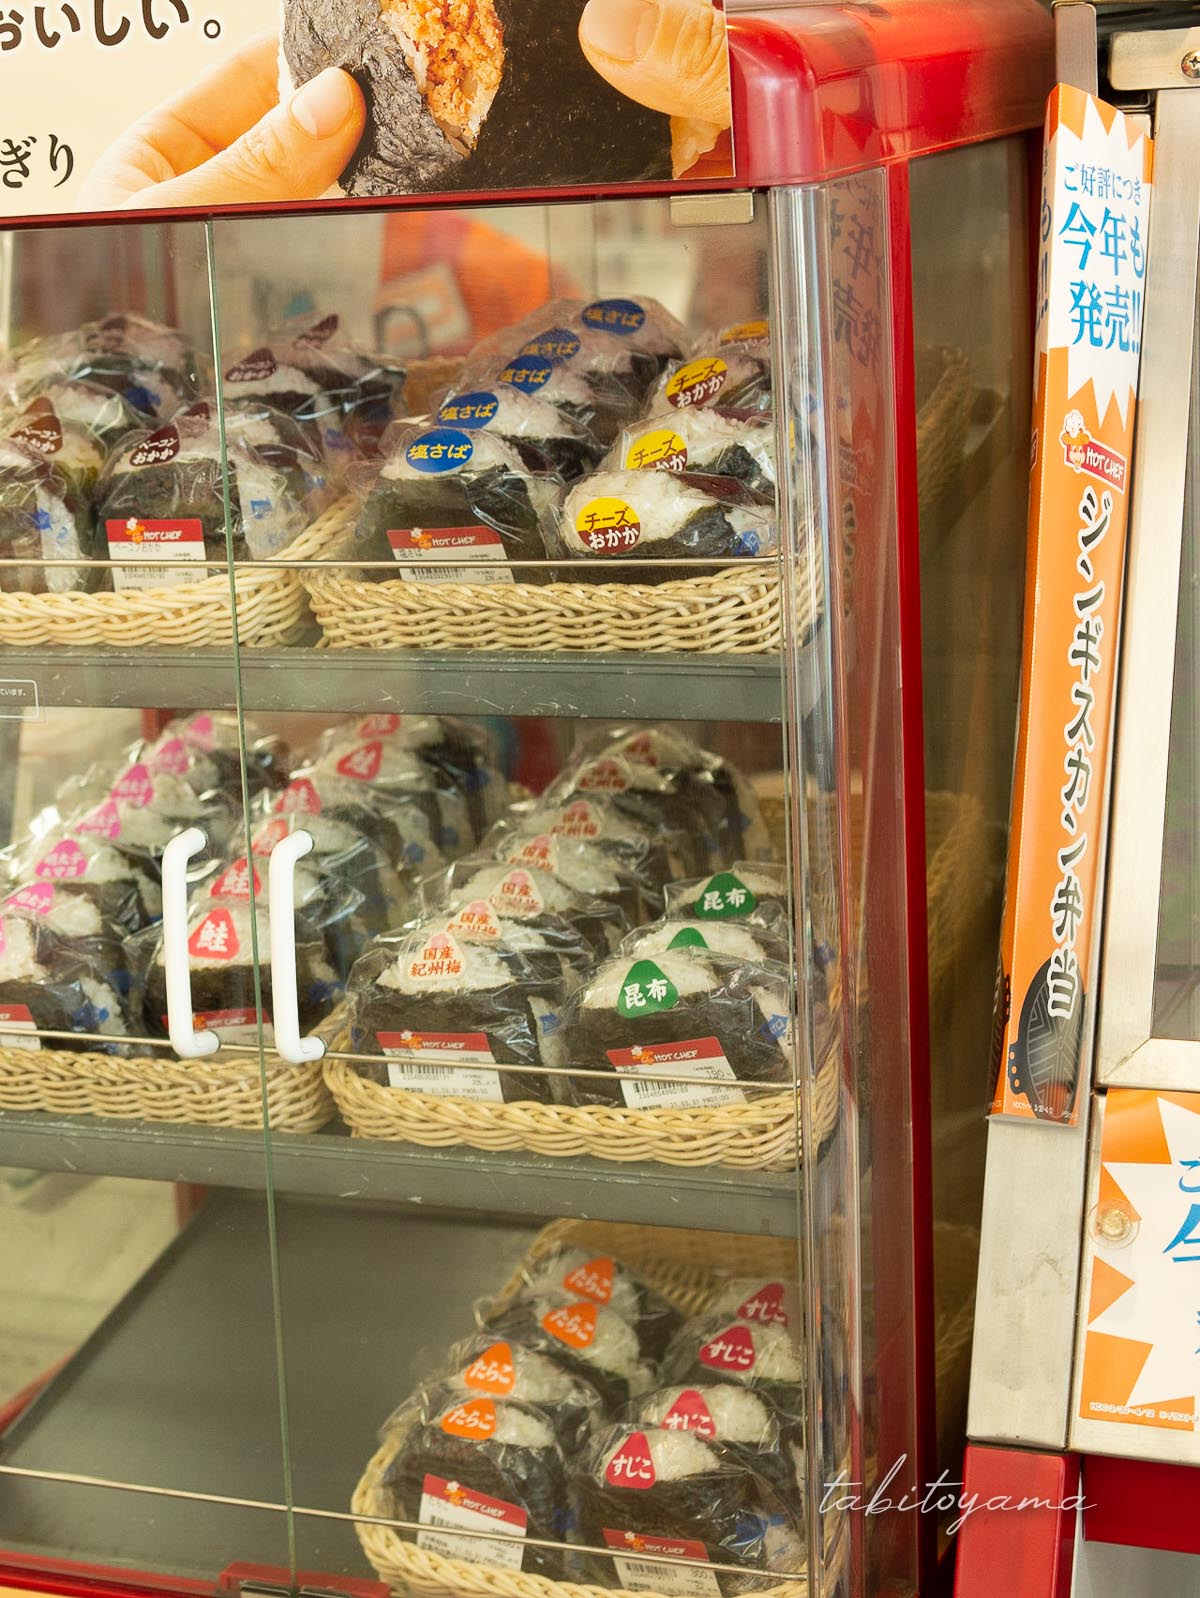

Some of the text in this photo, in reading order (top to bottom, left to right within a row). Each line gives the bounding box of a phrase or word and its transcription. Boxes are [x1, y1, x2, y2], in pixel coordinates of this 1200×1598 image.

[1064, 164, 1141, 206] ご好評につき
[1058, 202, 1145, 279] 今年も
[674, 359, 719, 391] チーズ
[676, 375, 727, 409] おかか
[441, 401, 498, 421] 塩さば
[140, 437, 178, 451] ベーコン
[406, 441, 472, 461] 塩さば
[633, 436, 677, 463] チーズ
[132, 448, 175, 466] おかか
[1086, 447, 1125, 481] HOT CHEF
[584, 506, 631, 531] チーズ
[143, 530, 182, 541] HOT CHEF
[432, 535, 477, 547] HOT CHEF
[589, 527, 640, 550] おかか
[1051, 490, 1112, 1011] ジンギスカン弁当
[703, 887, 747, 912] 昆布
[460, 911, 490, 925] 国産
[196, 919, 229, 954] 鮭
[423, 945, 454, 961] 国産
[410, 959, 463, 977] 紀州梅
[624, 978, 669, 1010] 昆布
[654, 1049, 698, 1062] HOT CHEF
[568, 1266, 612, 1301] たらこ
[745, 1299, 786, 1322] すじこ
[550, 1309, 595, 1342] たらこ
[708, 1340, 753, 1366] すじこ
[469, 1360, 513, 1385] たらこ
[447, 1407, 495, 1431] たらこ
[612, 1453, 652, 1480] すじこ
